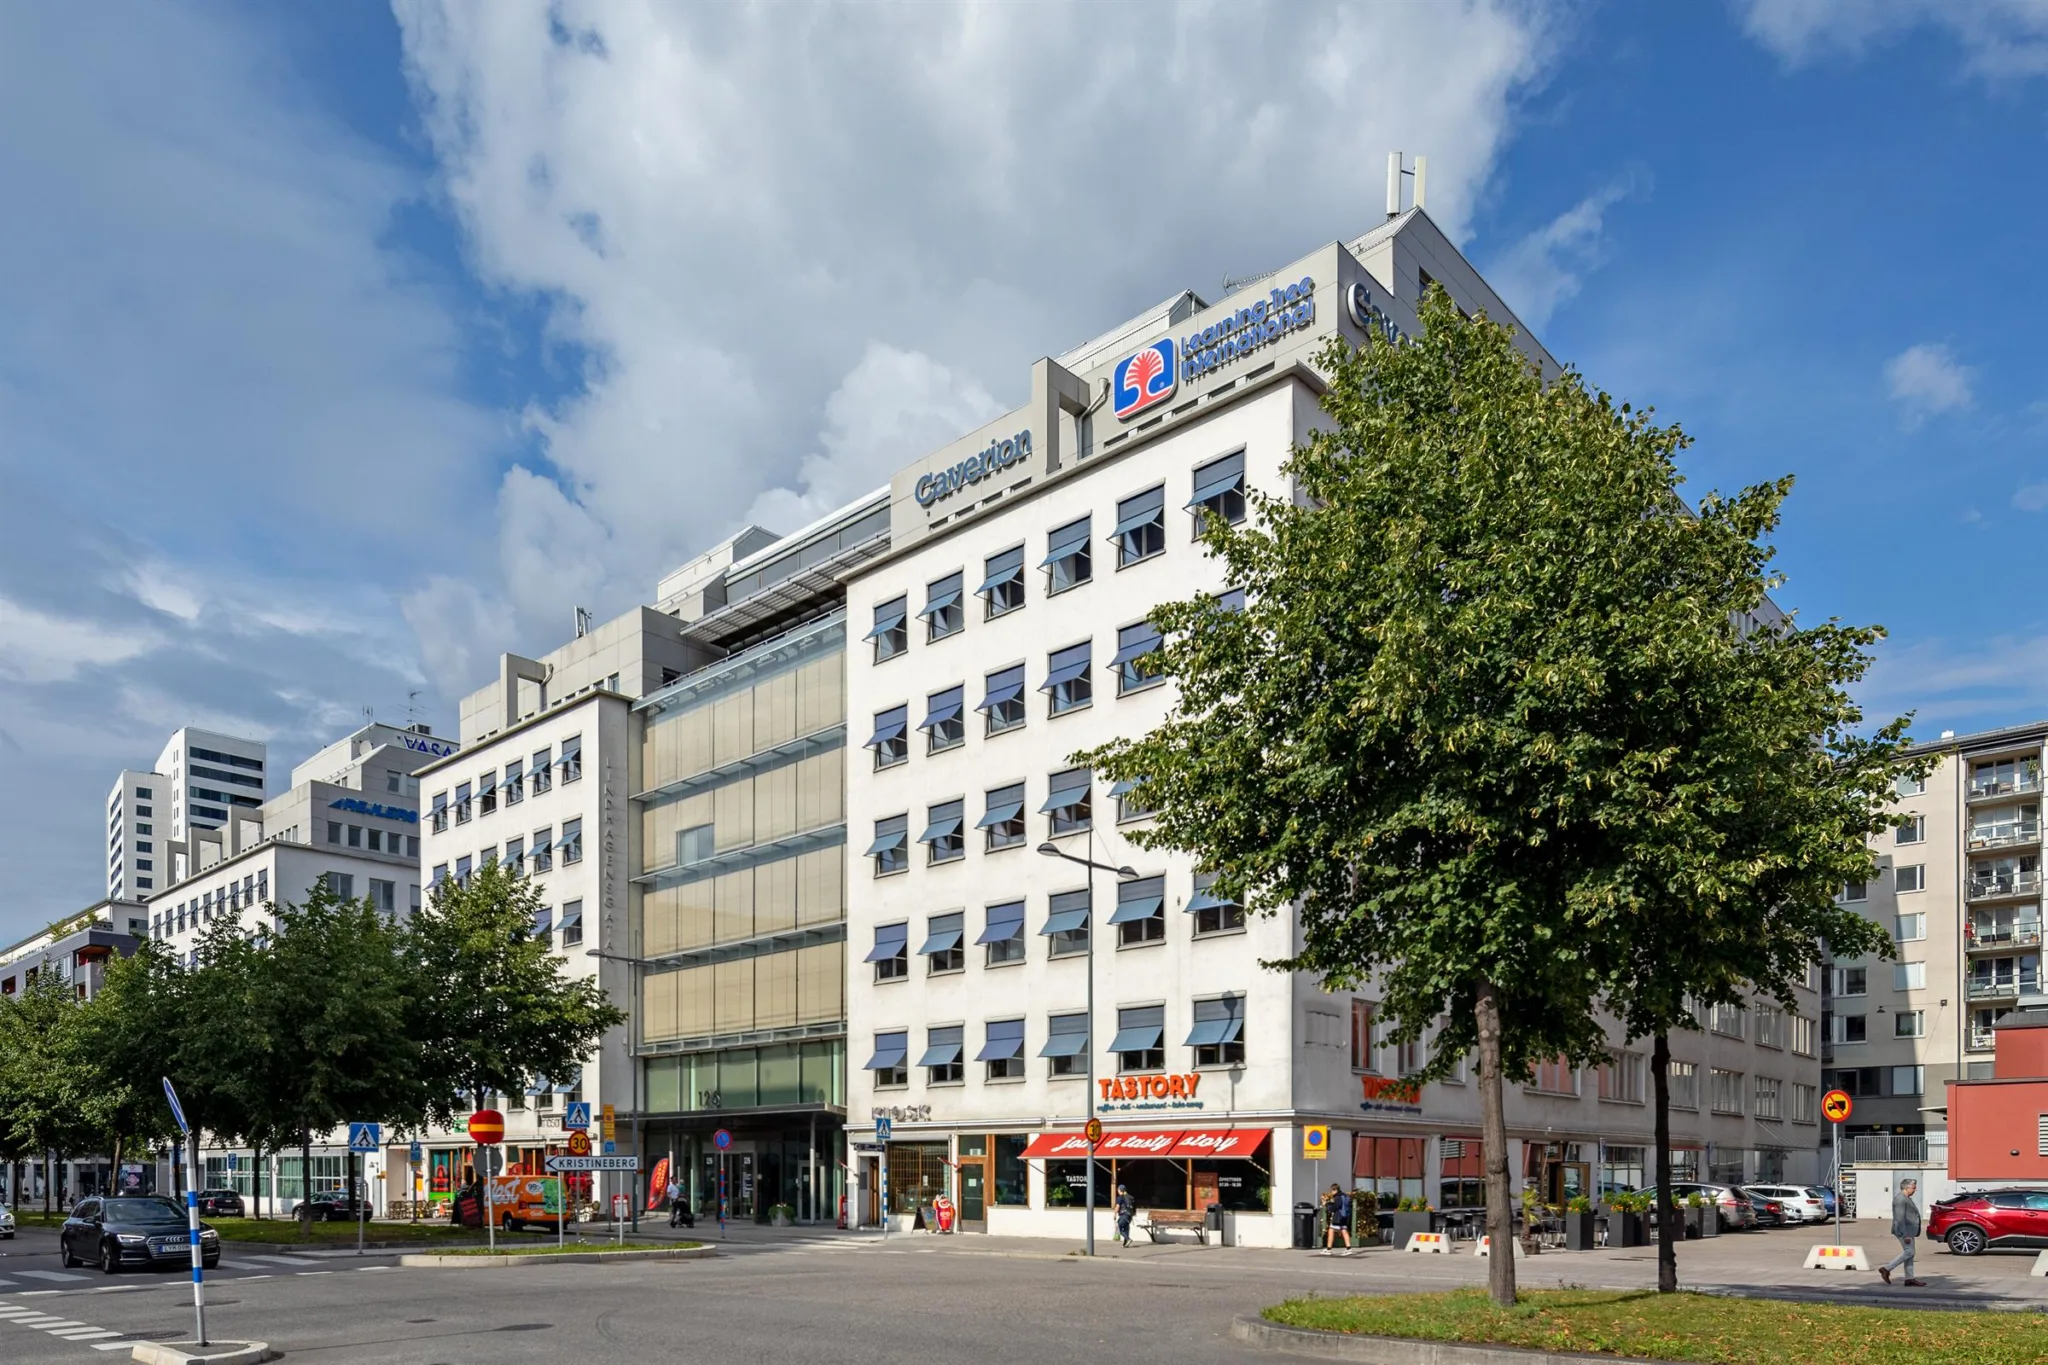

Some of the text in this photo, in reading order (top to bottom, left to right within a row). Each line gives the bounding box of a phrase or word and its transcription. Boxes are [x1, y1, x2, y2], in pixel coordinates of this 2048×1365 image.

[1181, 276, 1314, 357] Learning Tree
[1181, 297, 1314, 381] International
[914, 429, 1032, 506] Caverion
[1098, 1073, 1201, 1101] TASTORY
[871, 1104, 932, 1122] KIOSK
[573, 1137, 588, 1150] 30
[1104, 1137, 1122, 1148] a
[1121, 1135, 1173, 1152] tasty
[1179, 1134, 1240, 1152] story
[558, 1158, 636, 1168] KRISTINEBERG
